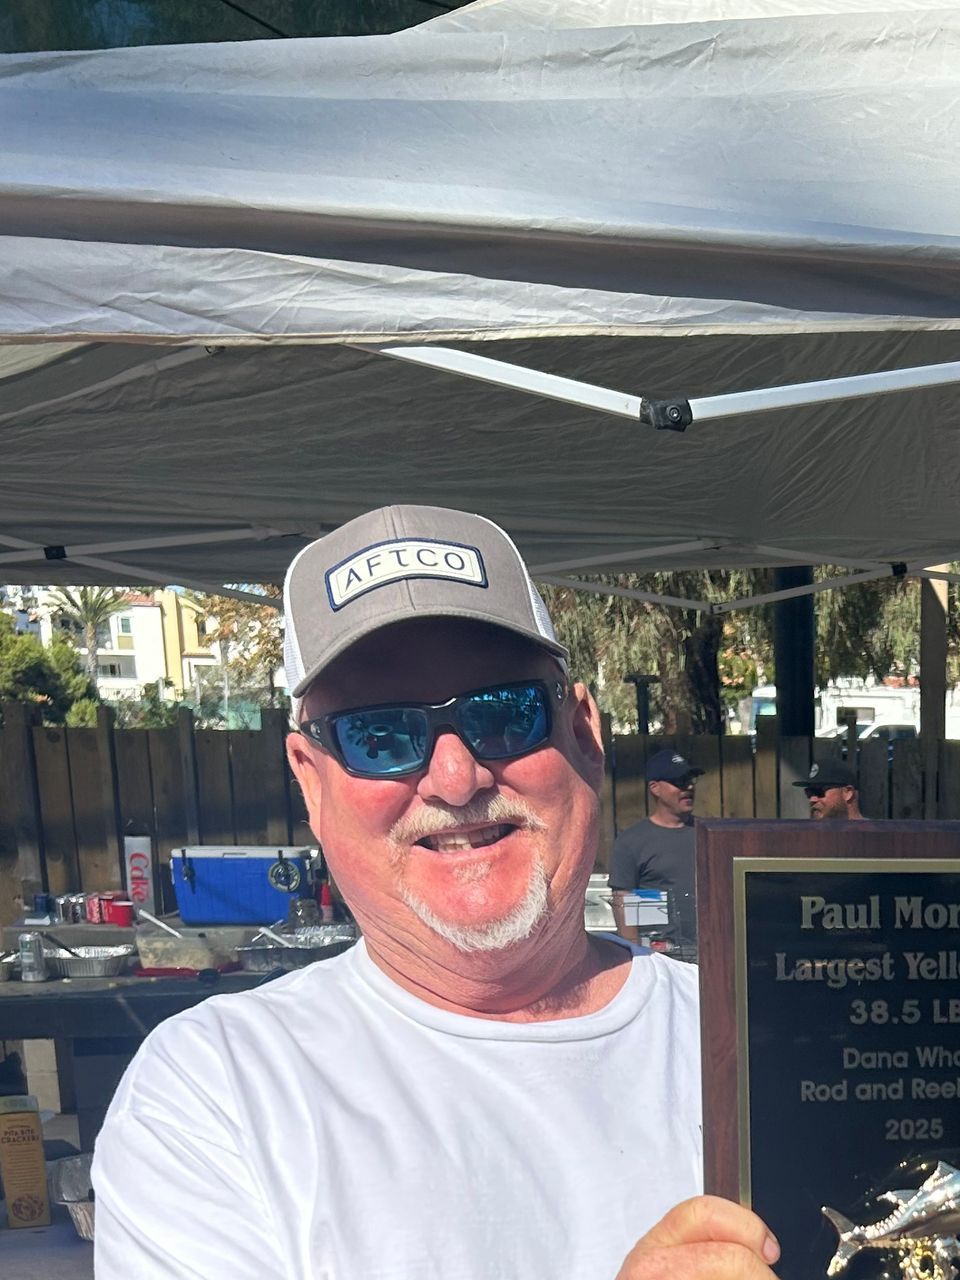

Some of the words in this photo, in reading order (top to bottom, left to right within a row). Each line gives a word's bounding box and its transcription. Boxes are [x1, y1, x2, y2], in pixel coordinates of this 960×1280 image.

[344, 549, 466, 591] AFTCO
[800, 895, 882, 929] Paul
[775, 952, 896, 989] Largest
[849, 1000, 921, 1025] 38.5
[842, 1046, 909, 1070] Dana
[800, 1080, 848, 1102] Rod
[855, 1079, 904, 1101] and
[885, 1118, 944, 1141] 2025
